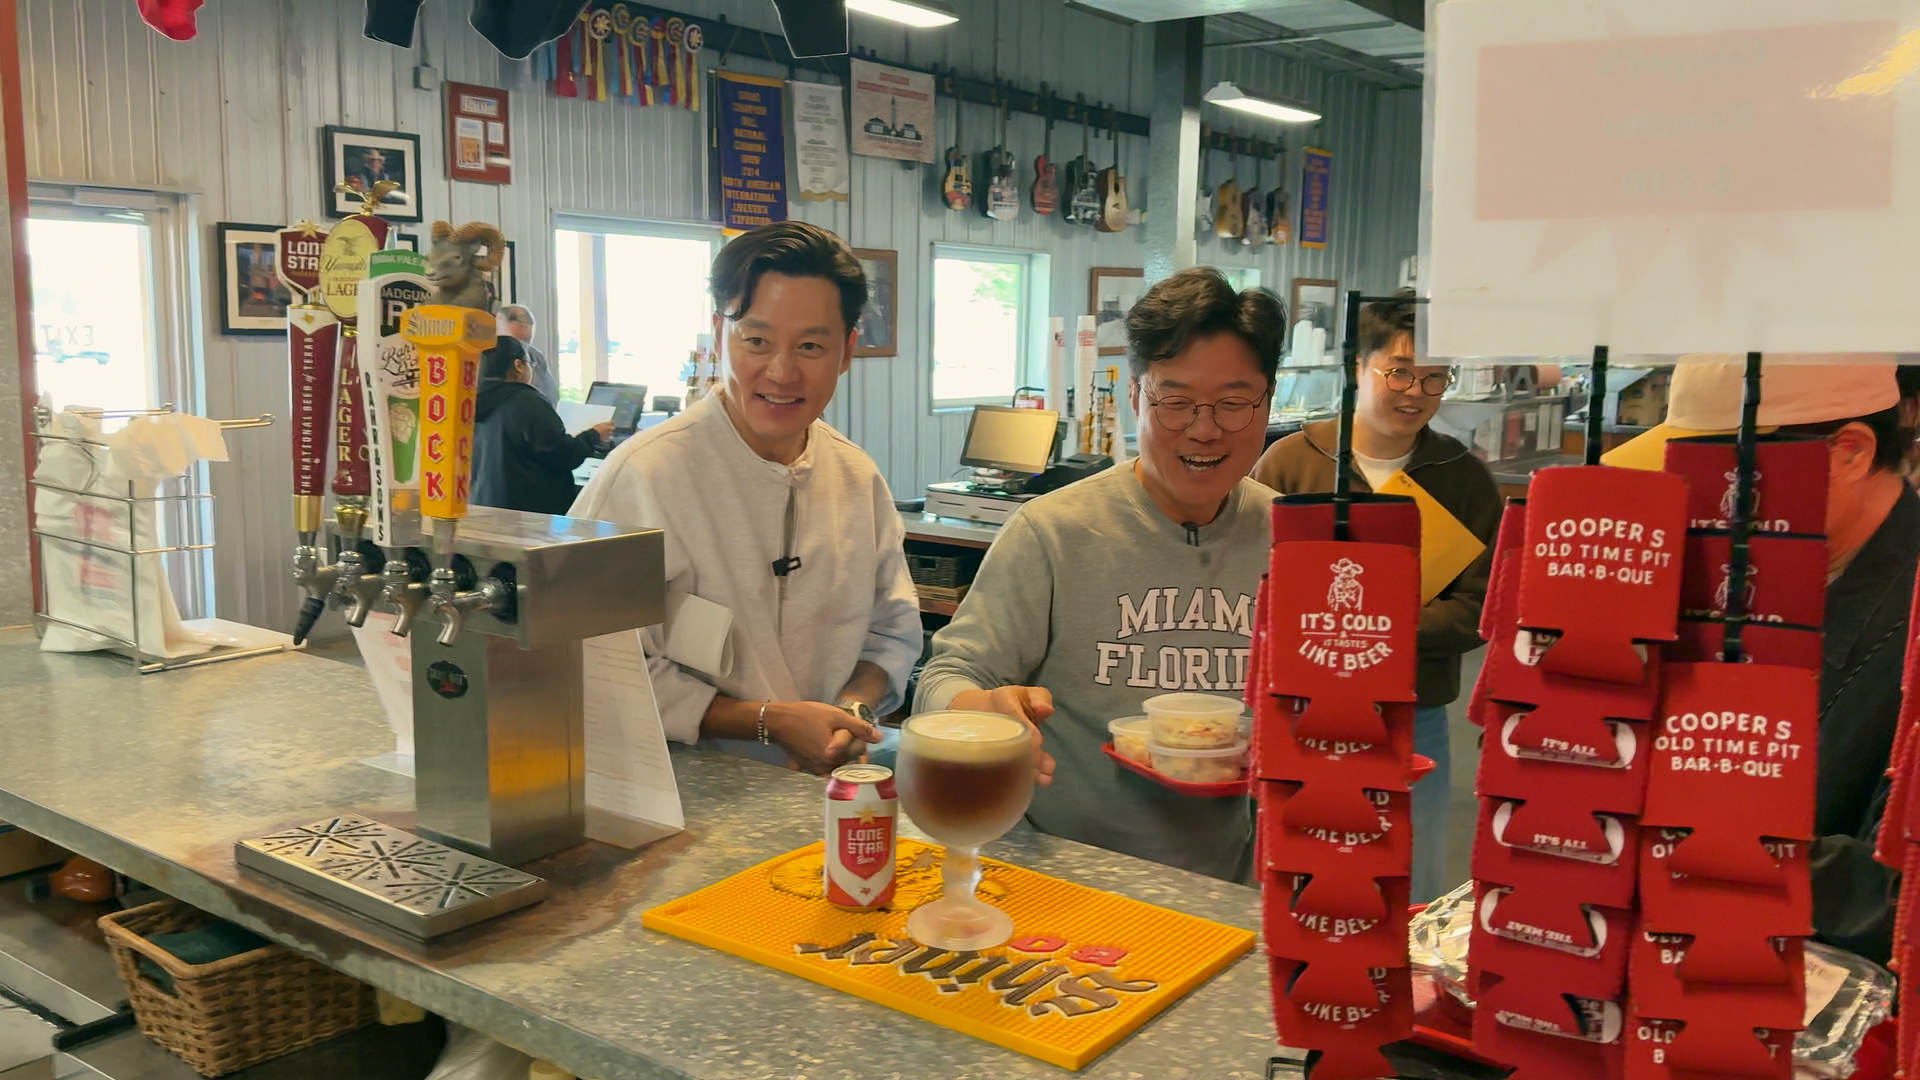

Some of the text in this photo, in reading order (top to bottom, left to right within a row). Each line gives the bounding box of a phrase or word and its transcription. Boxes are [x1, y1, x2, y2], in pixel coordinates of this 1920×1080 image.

[287, 240, 321, 256] LON
[287, 255, 320, 271] STA
[337, 369, 353, 463] LAGER
[425, 355, 447, 501] BOCK
[1545, 517, 1642, 542] COOPER
[1535, 543, 1672, 568] OLD TIME PIT
[1116, 586, 1258, 640] MIAM
[1300, 612, 1392, 632] IT'S COLD
[1298, 639, 1394, 671] LIKE BEER
[1666, 711, 1767, 736] COOPER
[1541, 737, 1600, 758] IT'S ALL
[1654, 736, 1802, 761] OLD TIME PIT
[847, 827, 886, 842] LONE
[1533, 833, 1591, 850] IT'S ALL
[847, 841, 886, 856] STAR
